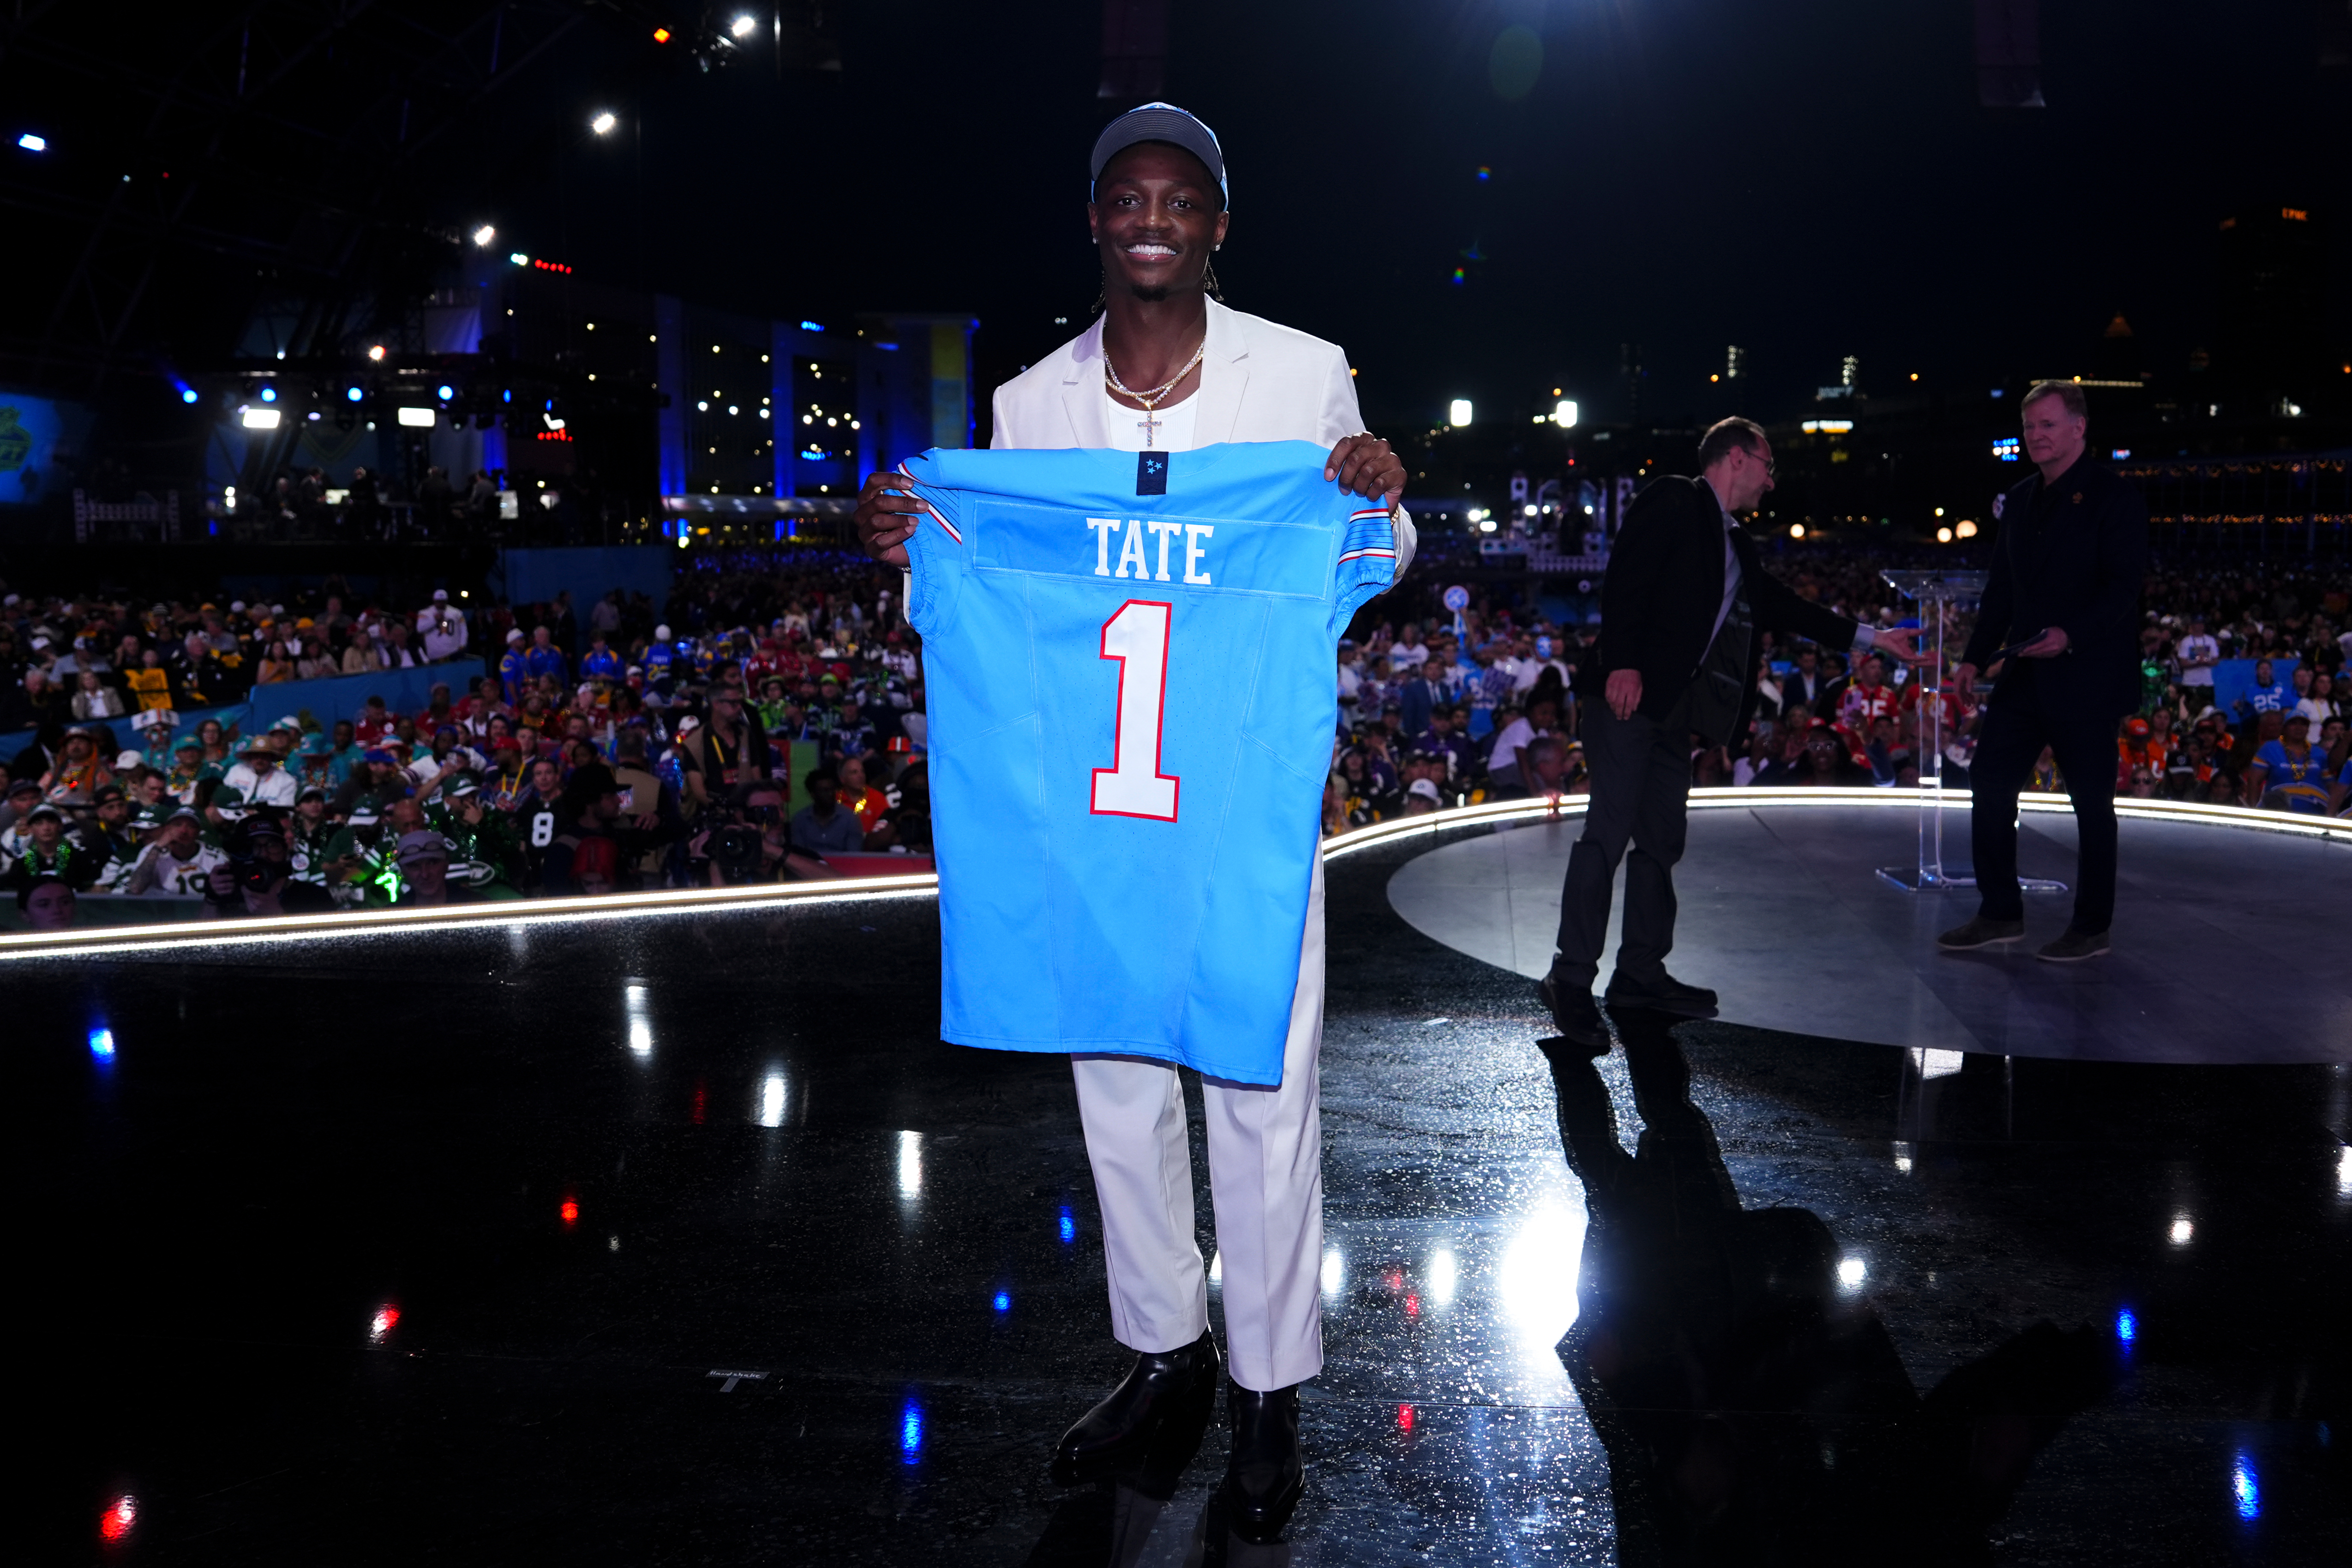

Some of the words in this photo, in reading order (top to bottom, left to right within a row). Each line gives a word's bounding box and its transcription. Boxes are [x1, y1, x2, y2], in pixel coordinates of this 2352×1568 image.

[1086, 517, 1215, 585] TATE
[1090, 599, 1180, 823] 1
[531, 812, 554, 847] 8
[710, 1370, 762, 1379] Handshake
